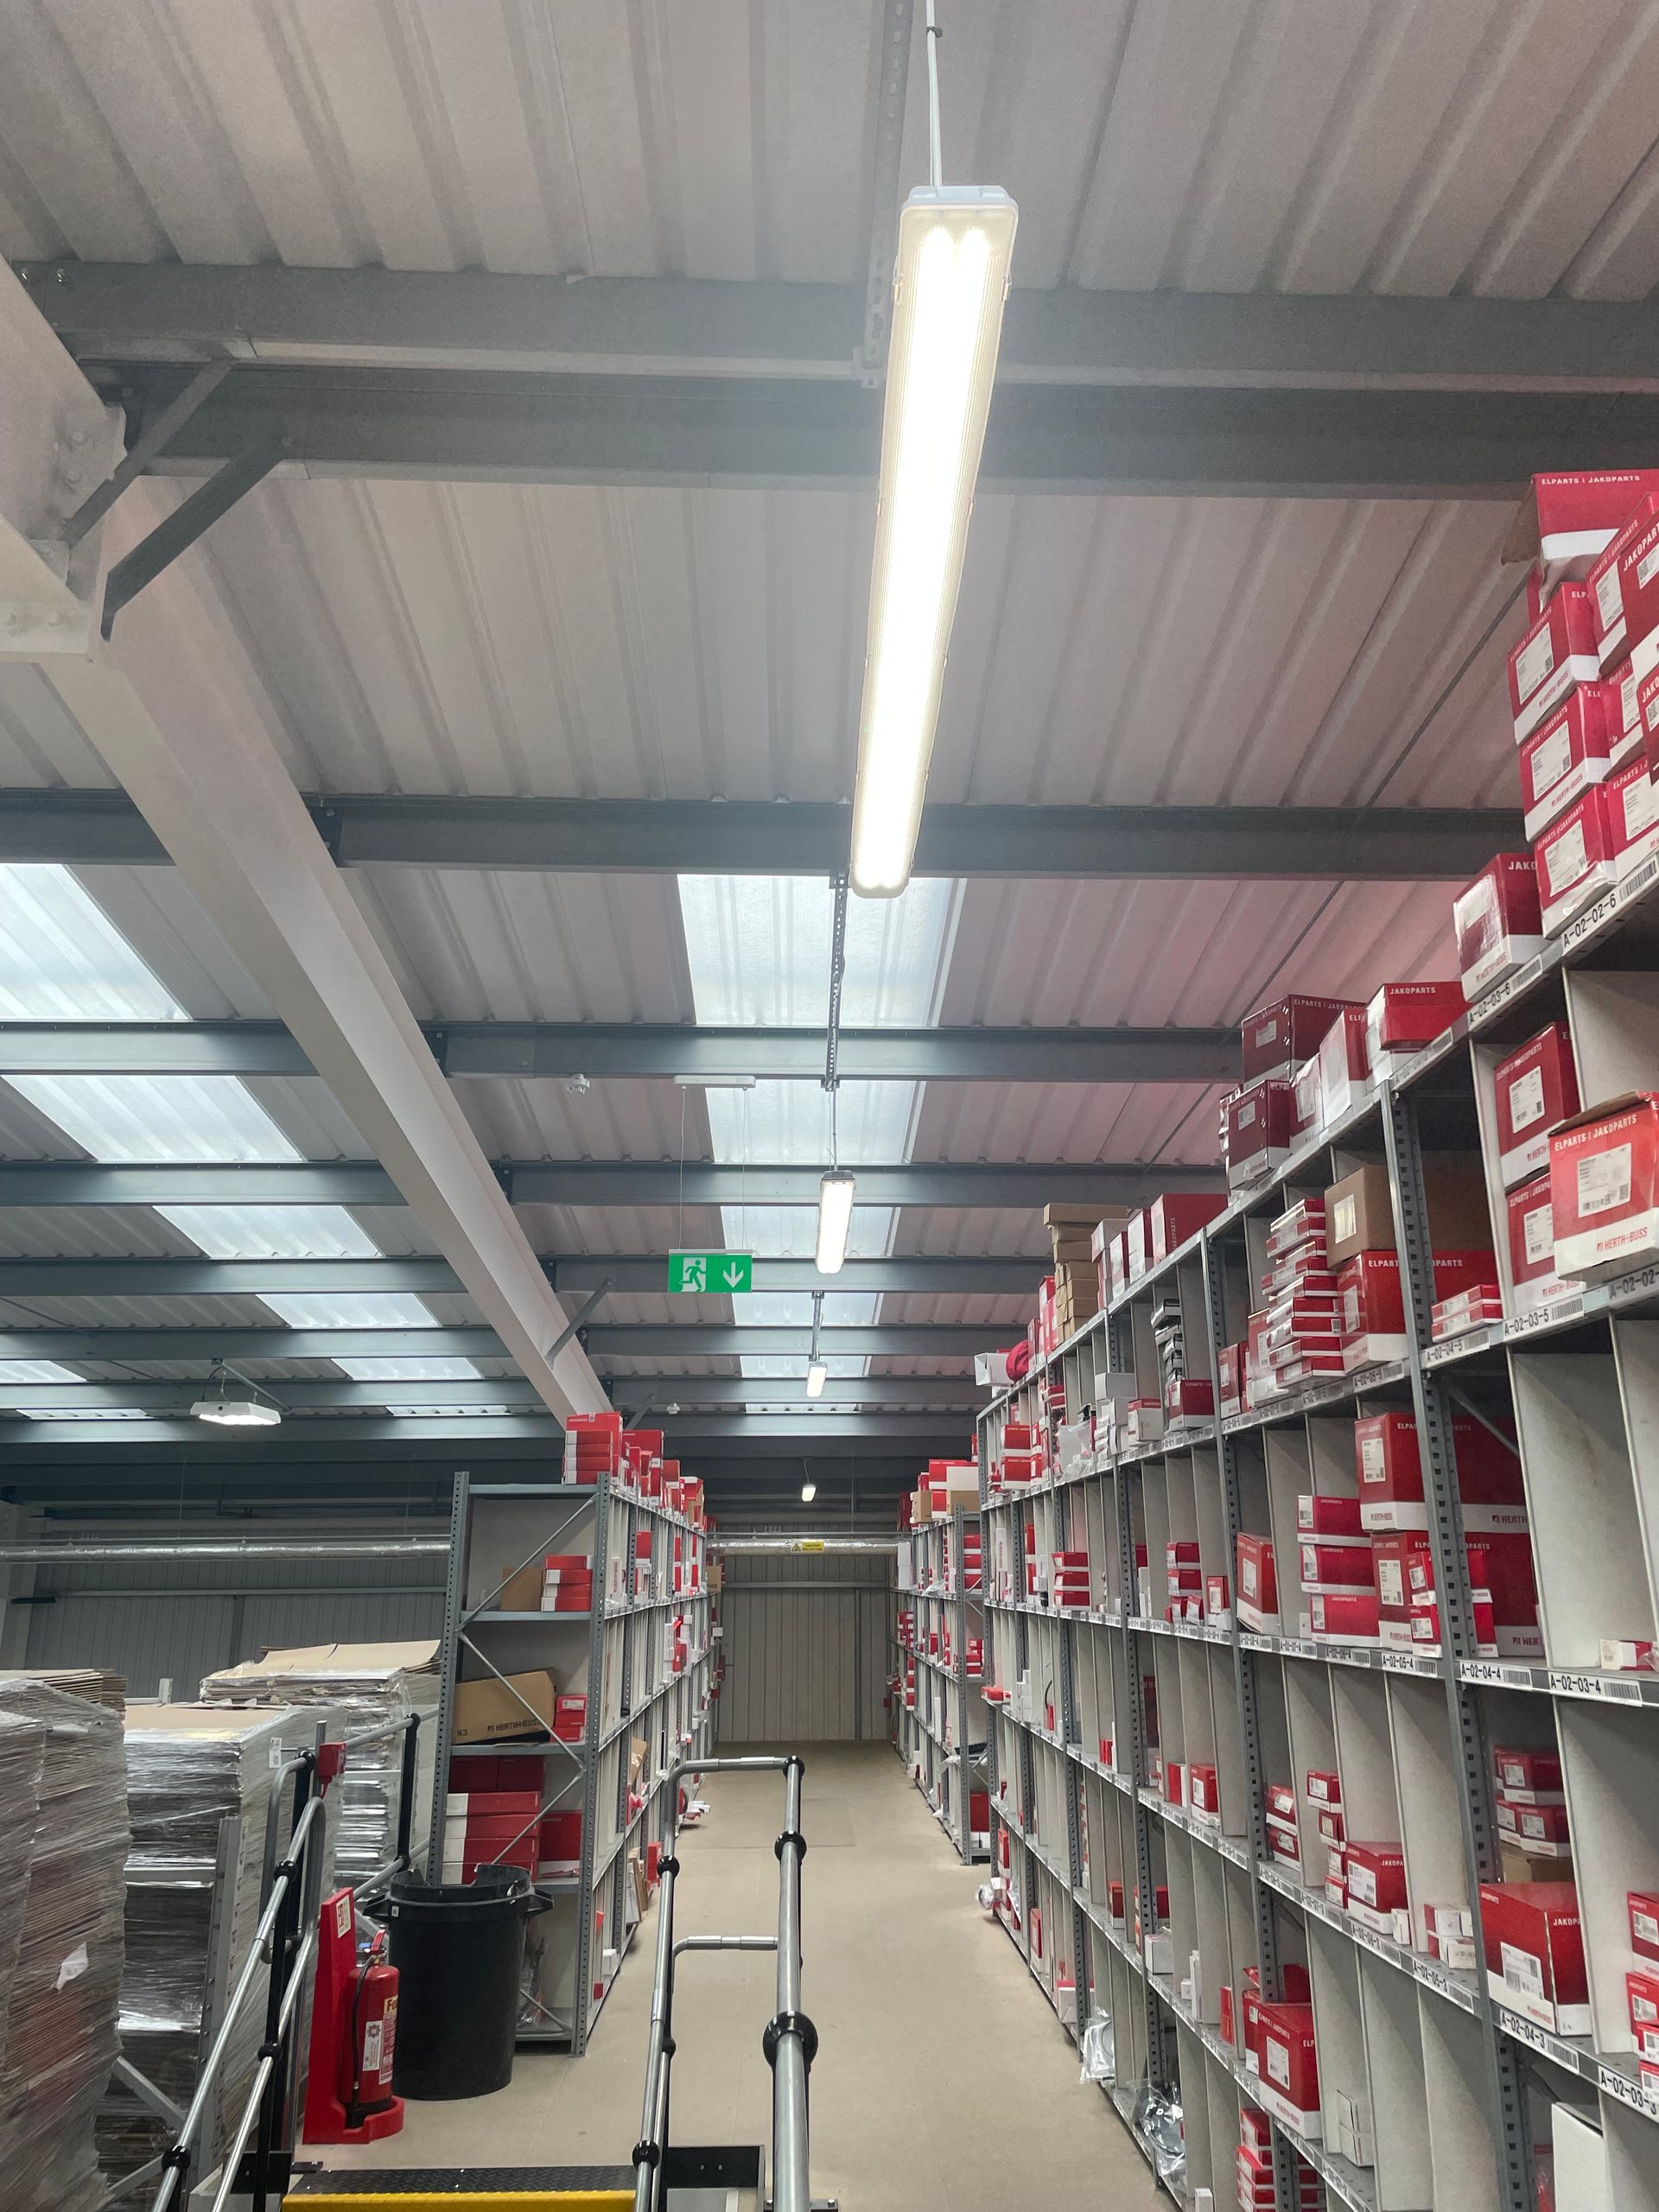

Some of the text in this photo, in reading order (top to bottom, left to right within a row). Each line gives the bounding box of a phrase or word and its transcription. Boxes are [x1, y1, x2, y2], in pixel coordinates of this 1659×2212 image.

[1564, 893, 1617, 947] A-02-02-6
[1469, 982, 1510, 1024] A-02-03-6
[1554, 1114, 1637, 1152] ELPARTS JAKOPARTS
[1604, 1227, 1648, 1249] HERTH+BUSS
[1504, 1308, 1549, 1336] A-02-03-5
[1382, 1656, 1414, 1669] A-02-05-4
[1461, 1663, 1501, 1680] A-02-04-4
[1550, 1675, 1601, 1694] A-02-03-4
[1414, 1961, 1448, 1993] A-02-05-3
[1502, 2013, 1545, 2049] A-02-04-3
